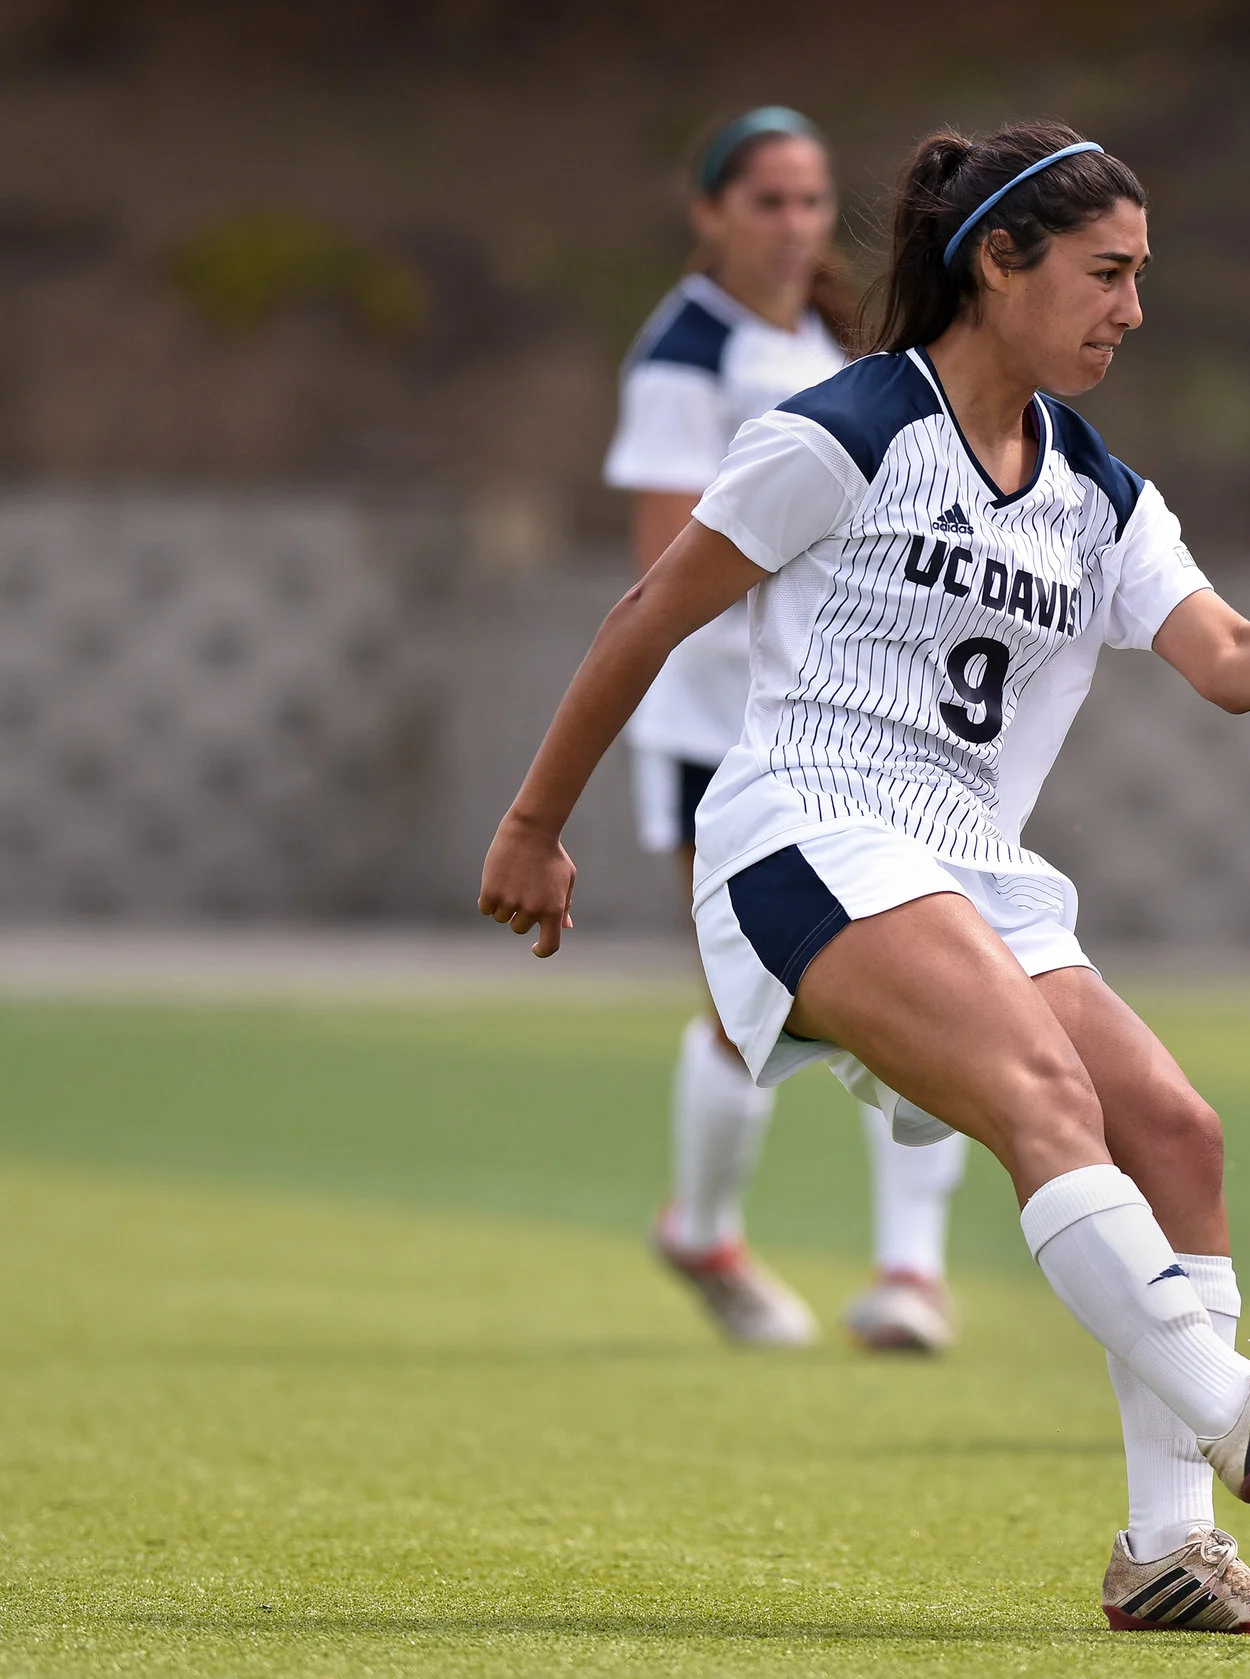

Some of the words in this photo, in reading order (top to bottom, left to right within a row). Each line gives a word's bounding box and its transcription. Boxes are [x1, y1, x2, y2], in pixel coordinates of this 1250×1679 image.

[932, 519, 975, 536] adidas
[904, 536, 974, 598] UC
[981, 558, 1078, 637] DAVIS
[939, 636, 1010, 744] 9
